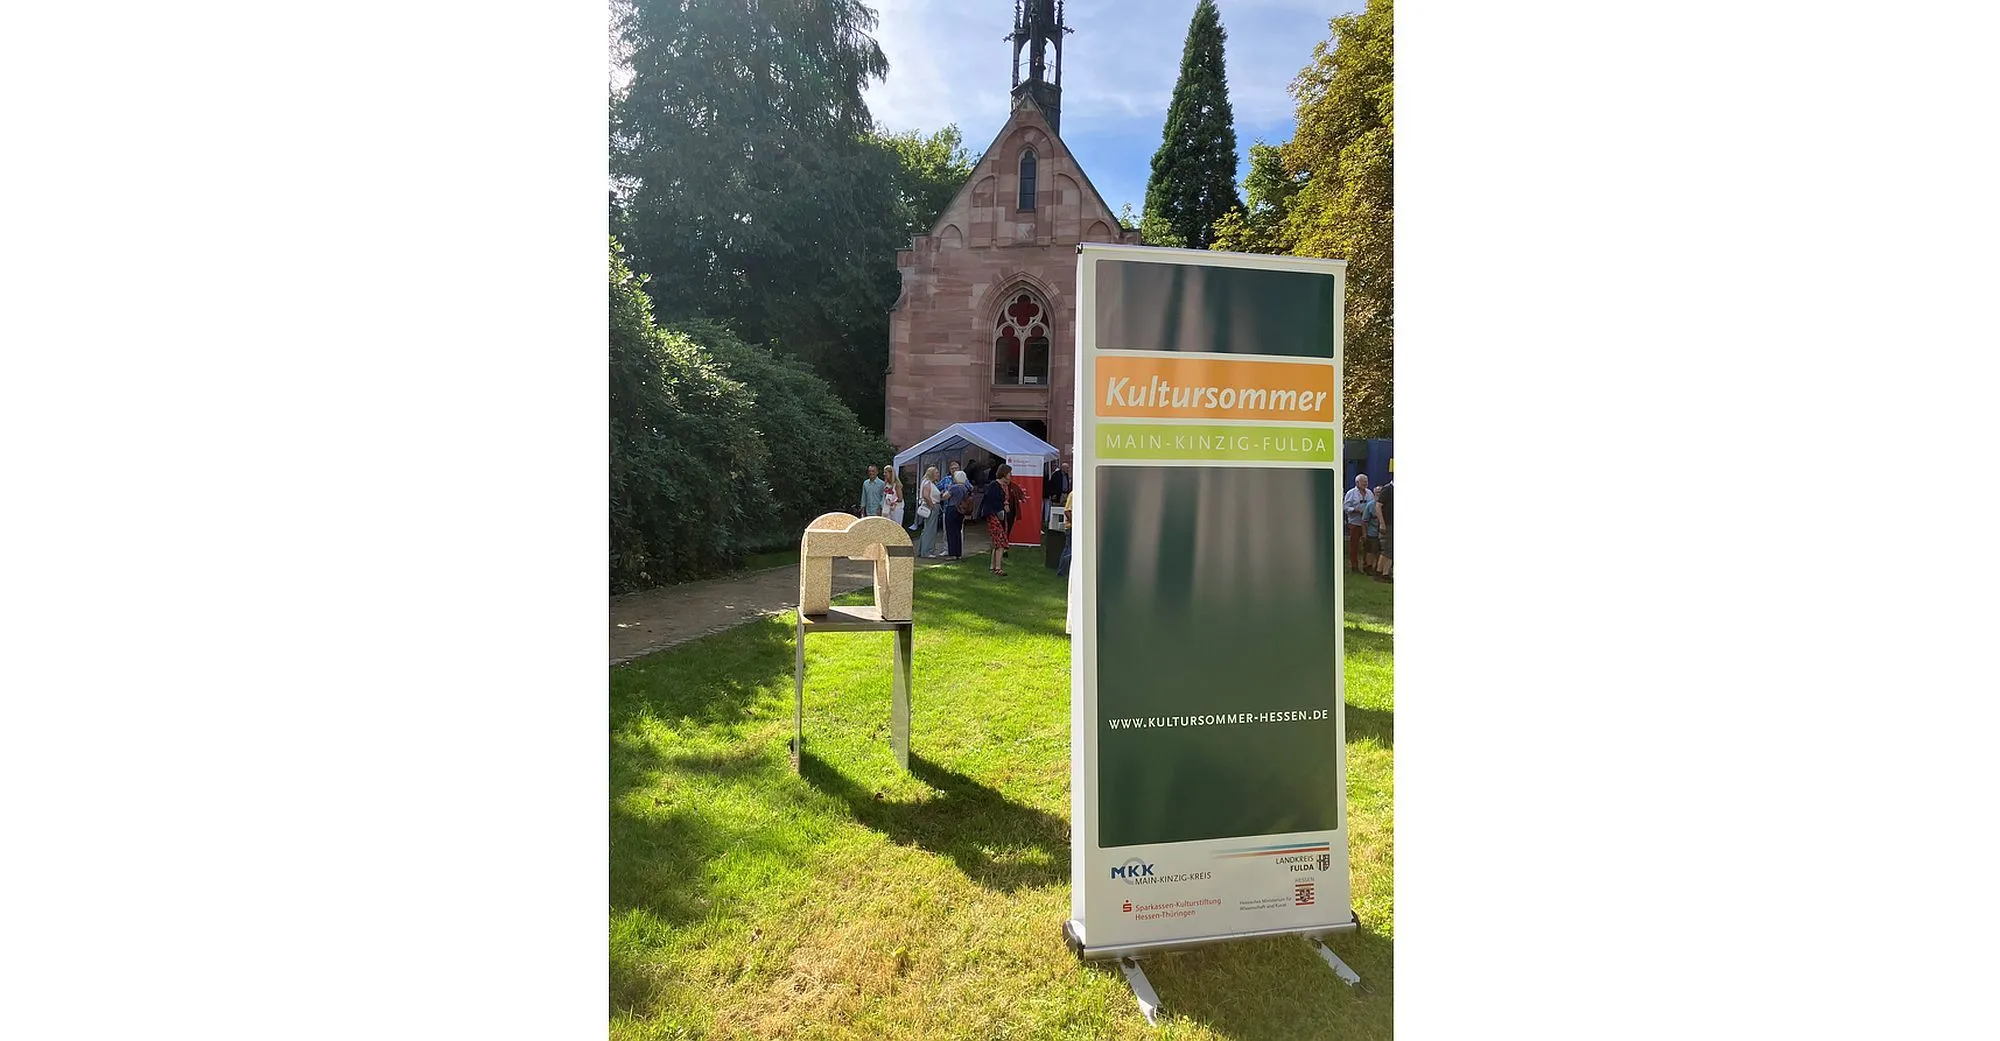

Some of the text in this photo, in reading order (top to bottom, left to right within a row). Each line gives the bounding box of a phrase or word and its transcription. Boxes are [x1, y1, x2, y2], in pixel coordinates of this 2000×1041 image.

[1105, 375, 1327, 412] Kultursommer
[1106, 433, 1327, 453] MAIN-KINZIG-FULDA
[1109, 709, 1329, 730] WWW.KULTURSOMMER-HESSEN.DE
[1275, 856, 1314, 865] LANDKREIS
[1111, 864, 1155, 879] MKK
[1290, 864, 1314, 872] FULDA
[1134, 871, 1212, 885] MAIN-KINZIG-KREIS
[1135, 898, 1222, 912] Sparkassen-Kulturstiftung
[1135, 909, 1196, 921] Hessen-Thüringen
